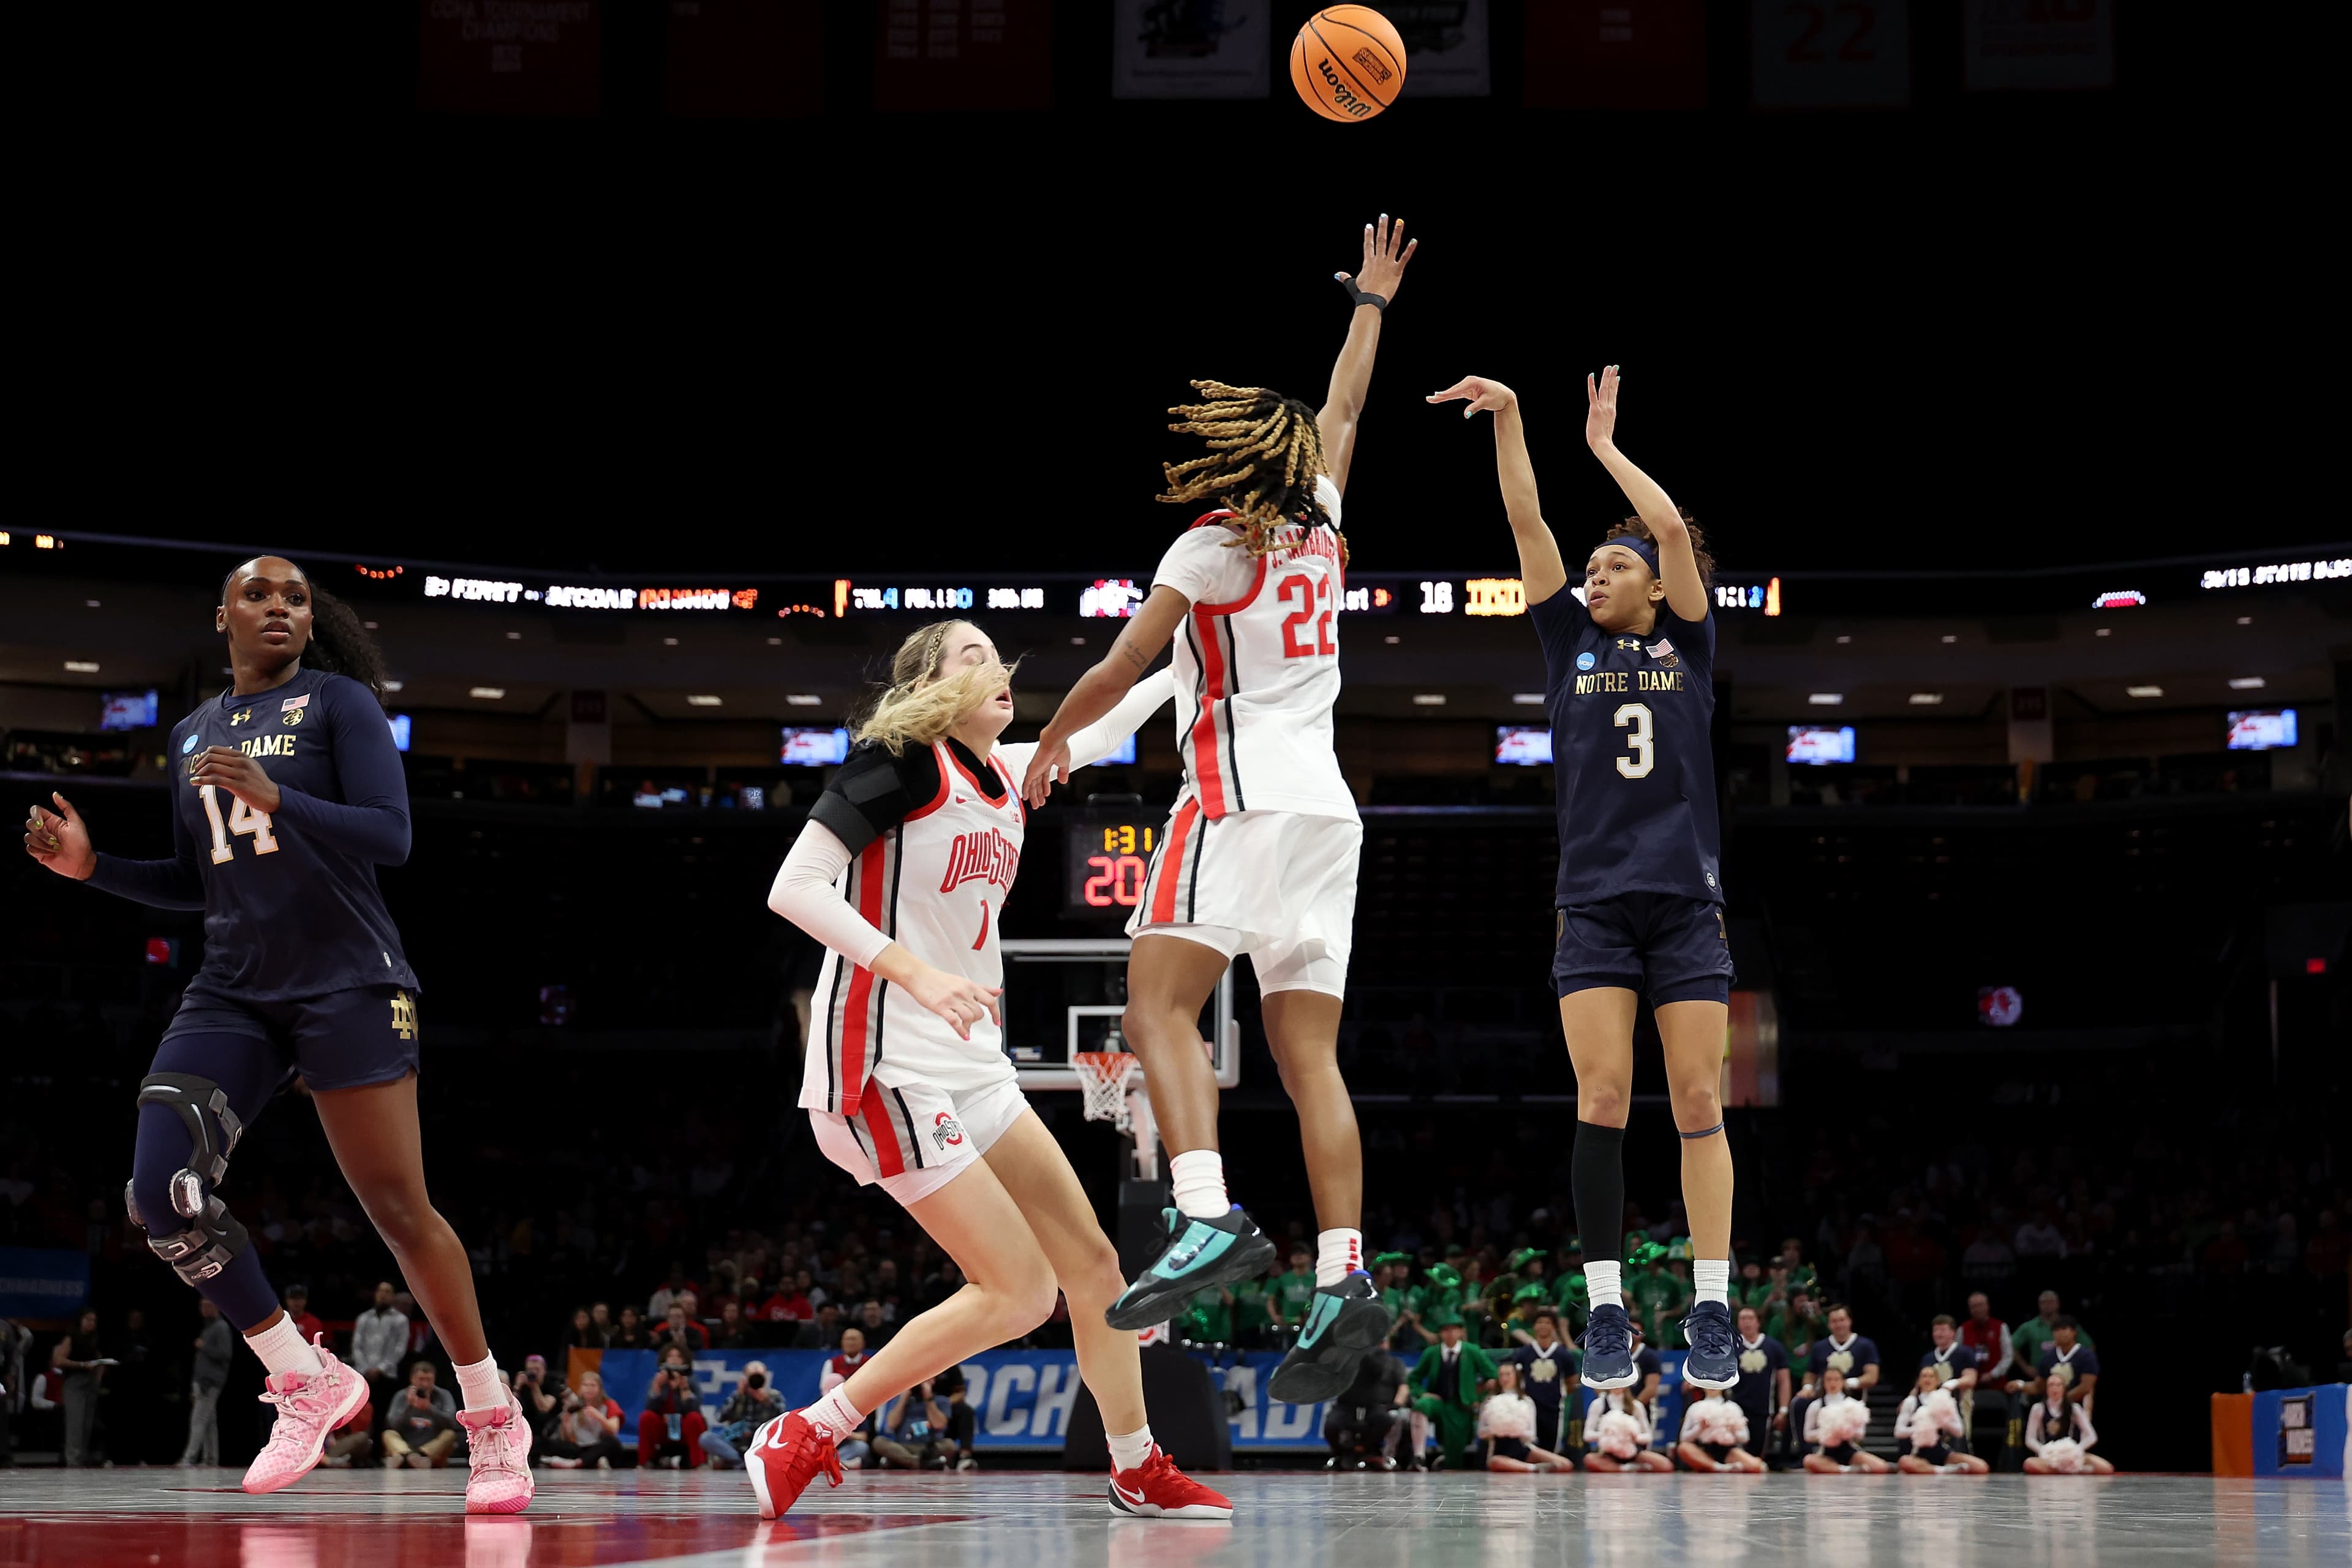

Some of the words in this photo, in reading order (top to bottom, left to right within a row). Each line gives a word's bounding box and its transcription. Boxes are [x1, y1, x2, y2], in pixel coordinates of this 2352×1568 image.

[1784, 5, 1876, 62] 22
[1318, 58, 1372, 117] Wilson
[1278, 573, 1335, 658] 22
[1420, 581, 1453, 613] 16
[1575, 672, 1629, 695] NOTRE
[1637, 671, 1684, 692] DAME
[241, 734, 297, 760] DAME
[1613, 703, 1654, 779] 3
[198, 784, 279, 865] 14
[1104, 825, 1153, 855] 1:31
[1084, 856, 1145, 907] 20
[971, 899, 989, 951] 1
